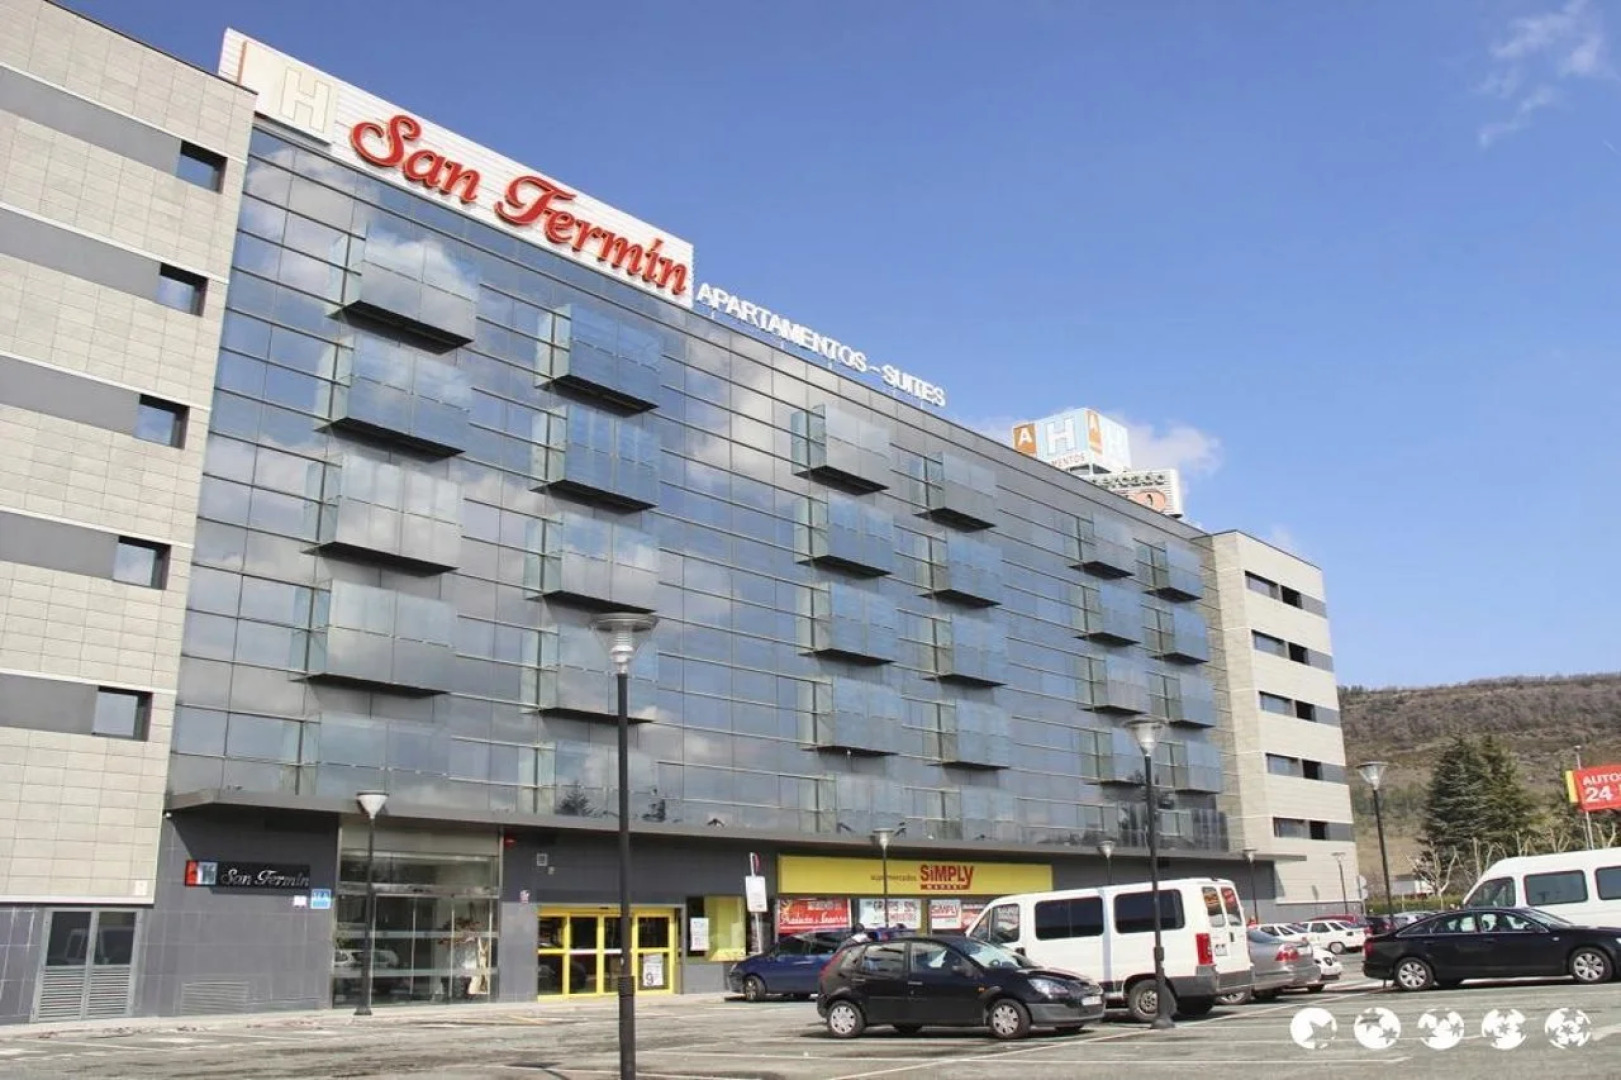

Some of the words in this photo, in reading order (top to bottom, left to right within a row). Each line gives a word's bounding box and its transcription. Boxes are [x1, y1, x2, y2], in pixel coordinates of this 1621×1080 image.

[351, 114, 482, 203] San
[494, 174, 688, 295] Fermín
[696, 283, 868, 372] APARTAMENTOS
[881, 364, 946, 407] SUITES
[1050, 452, 1085, 468] MENTOS
[1585, 785, 1614, 803] 24
